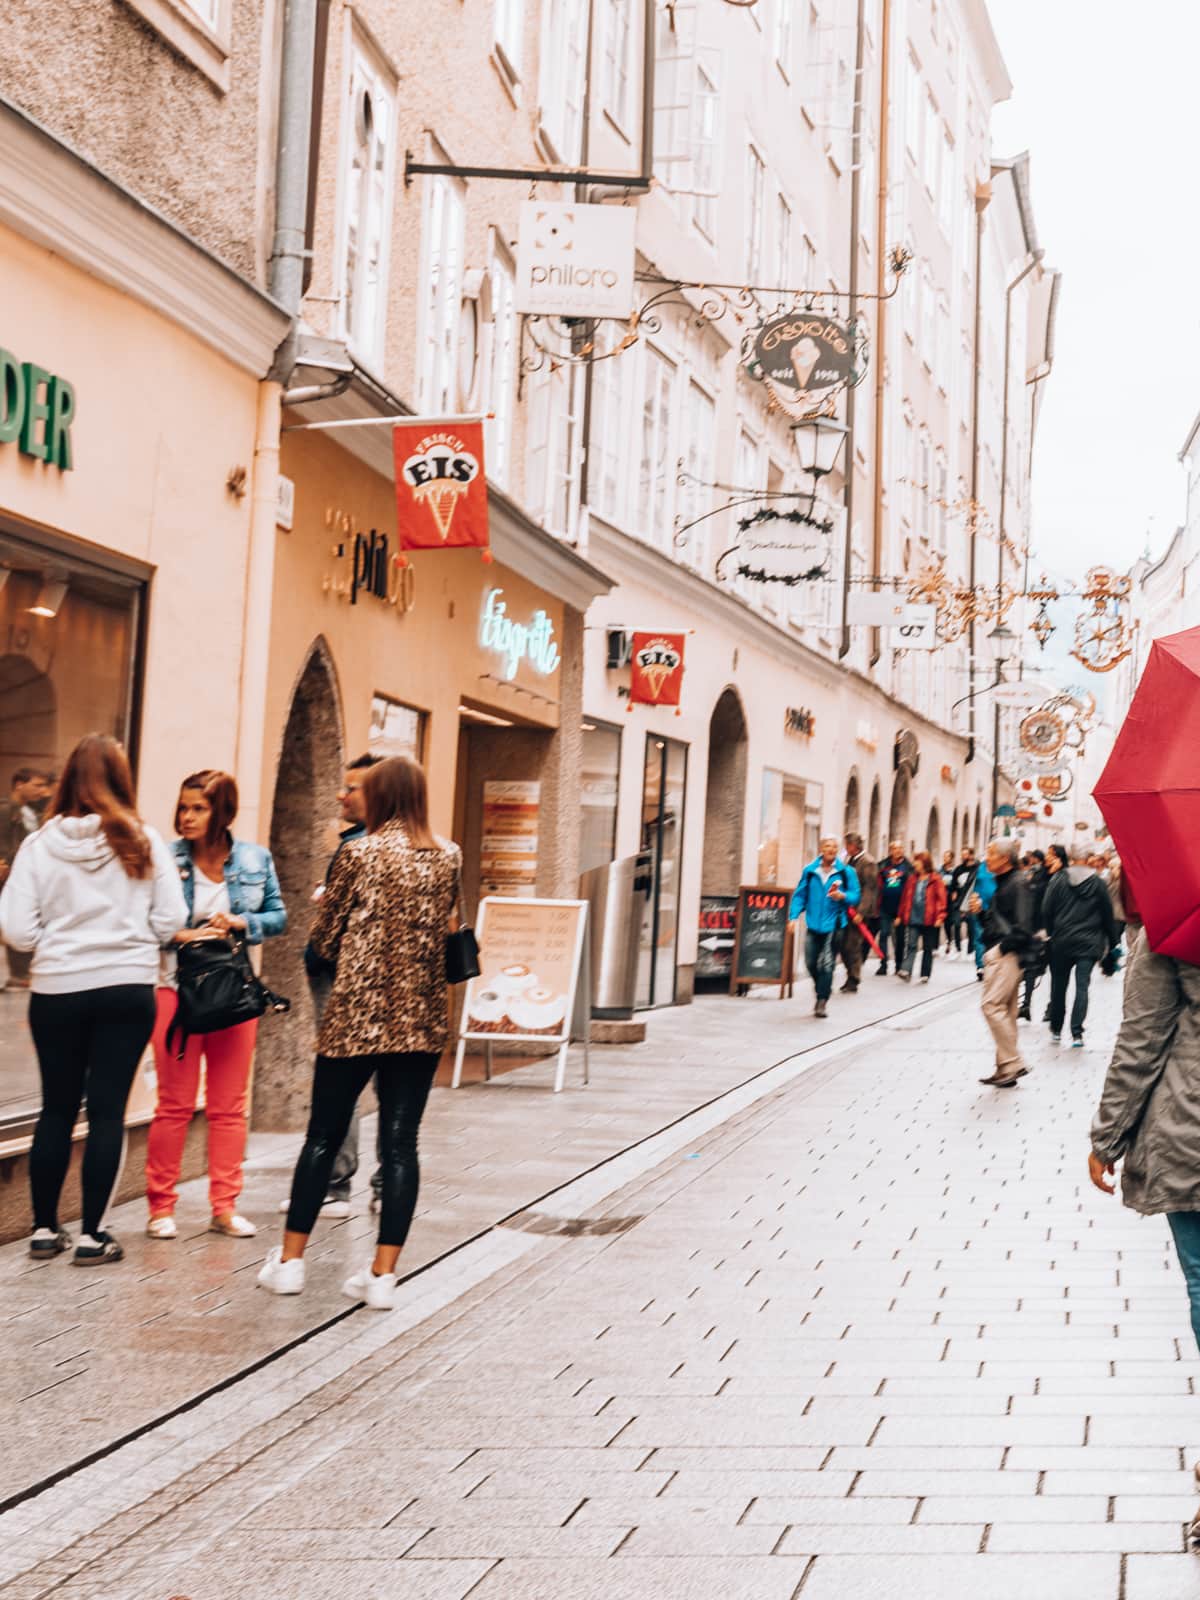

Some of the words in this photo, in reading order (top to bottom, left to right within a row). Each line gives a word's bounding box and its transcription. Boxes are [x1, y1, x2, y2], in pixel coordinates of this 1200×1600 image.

[530, 264, 618, 289] philoro
[414, 433, 465, 454] FRISCH
[408, 457, 474, 487] EIS
[640, 651, 678, 667] EIS
